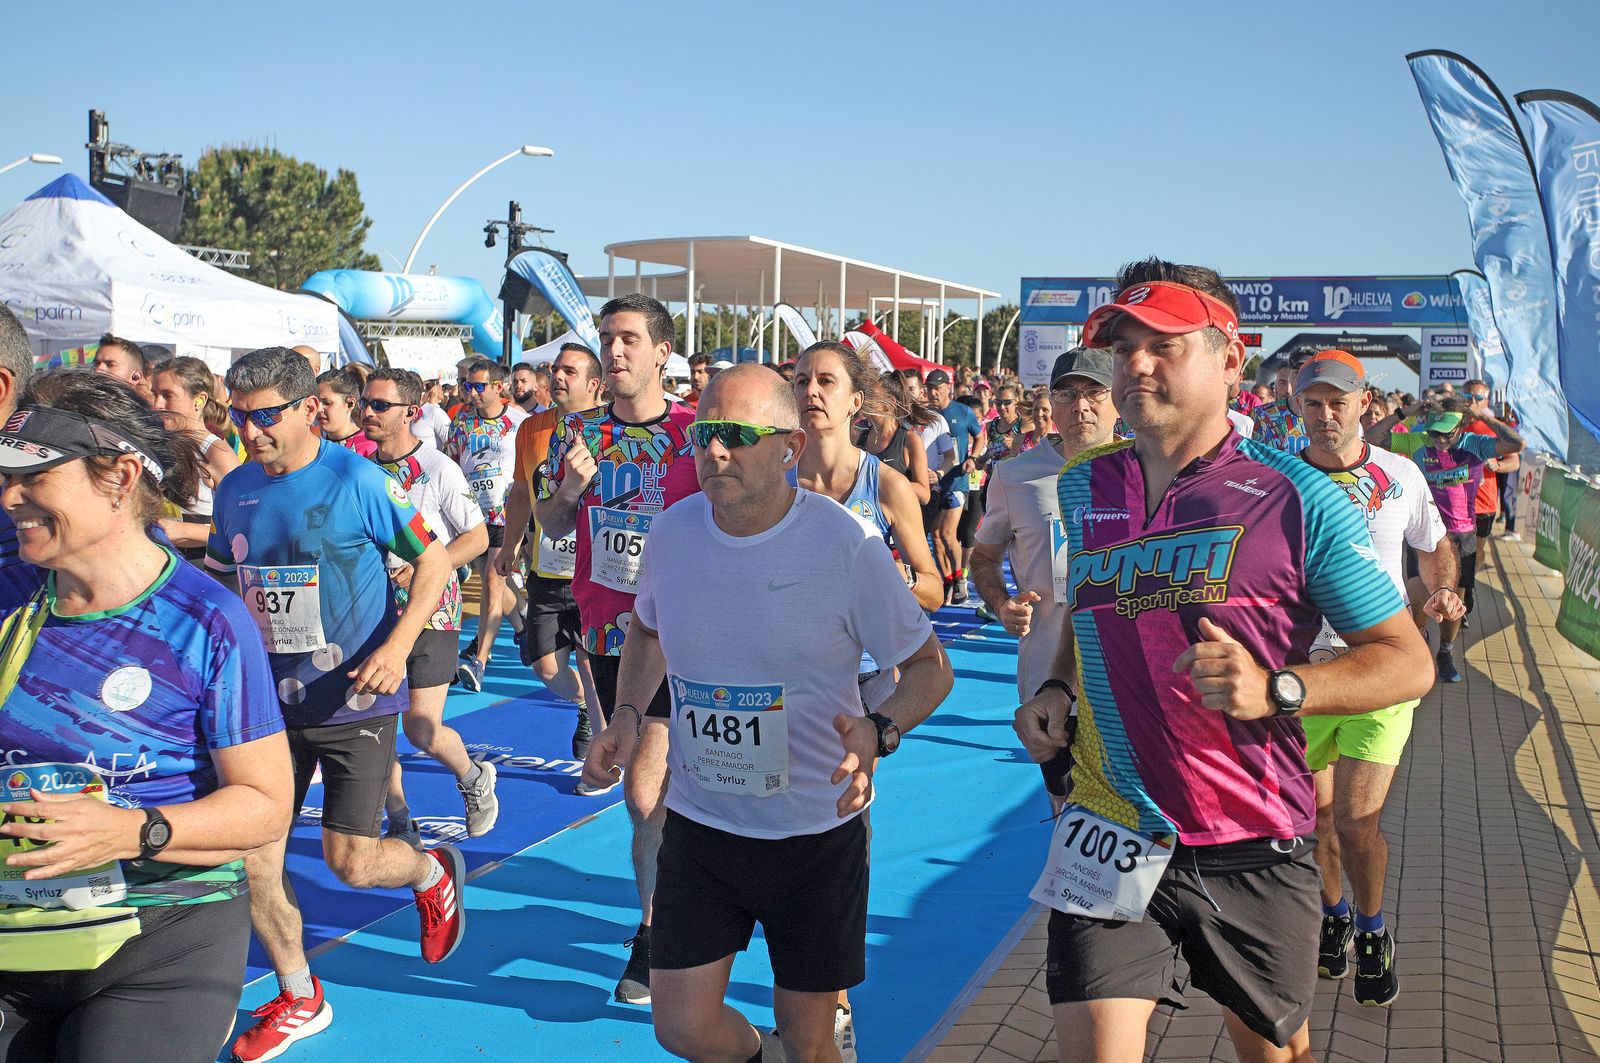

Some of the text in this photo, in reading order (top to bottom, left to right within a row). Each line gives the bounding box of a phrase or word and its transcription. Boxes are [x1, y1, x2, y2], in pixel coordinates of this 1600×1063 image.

[1249, 296, 1309, 312] 10 km
[1350, 292, 1393, 306] HUELVA
[1281, 313, 1308, 321] Master
[0, 436, 50, 459] RESS
[472, 479, 494, 492] 959
[1073, 506, 1130, 524] Conquero
[285, 572, 309, 583] 2023
[256, 591, 295, 614] 937
[270, 637, 293, 645] Syrluz
[687, 688, 710, 700] HUELVA
[738, 692, 772, 707] 2023
[686, 710, 761, 746] 1481
[704, 748, 743, 760] SANTIAGO
[698, 755, 755, 771] PEREZ AMADOR
[40, 770, 87, 792] 2023
[716, 773, 746, 786] Syrluz
[1064, 818, 1142, 873] 1003
[1071, 862, 1101, 881] ANDRES
[25, 887, 63, 900] Syrluz
[1078, 878, 1113, 899] MARIANO
[1061, 888, 1094, 911] Syrluz
